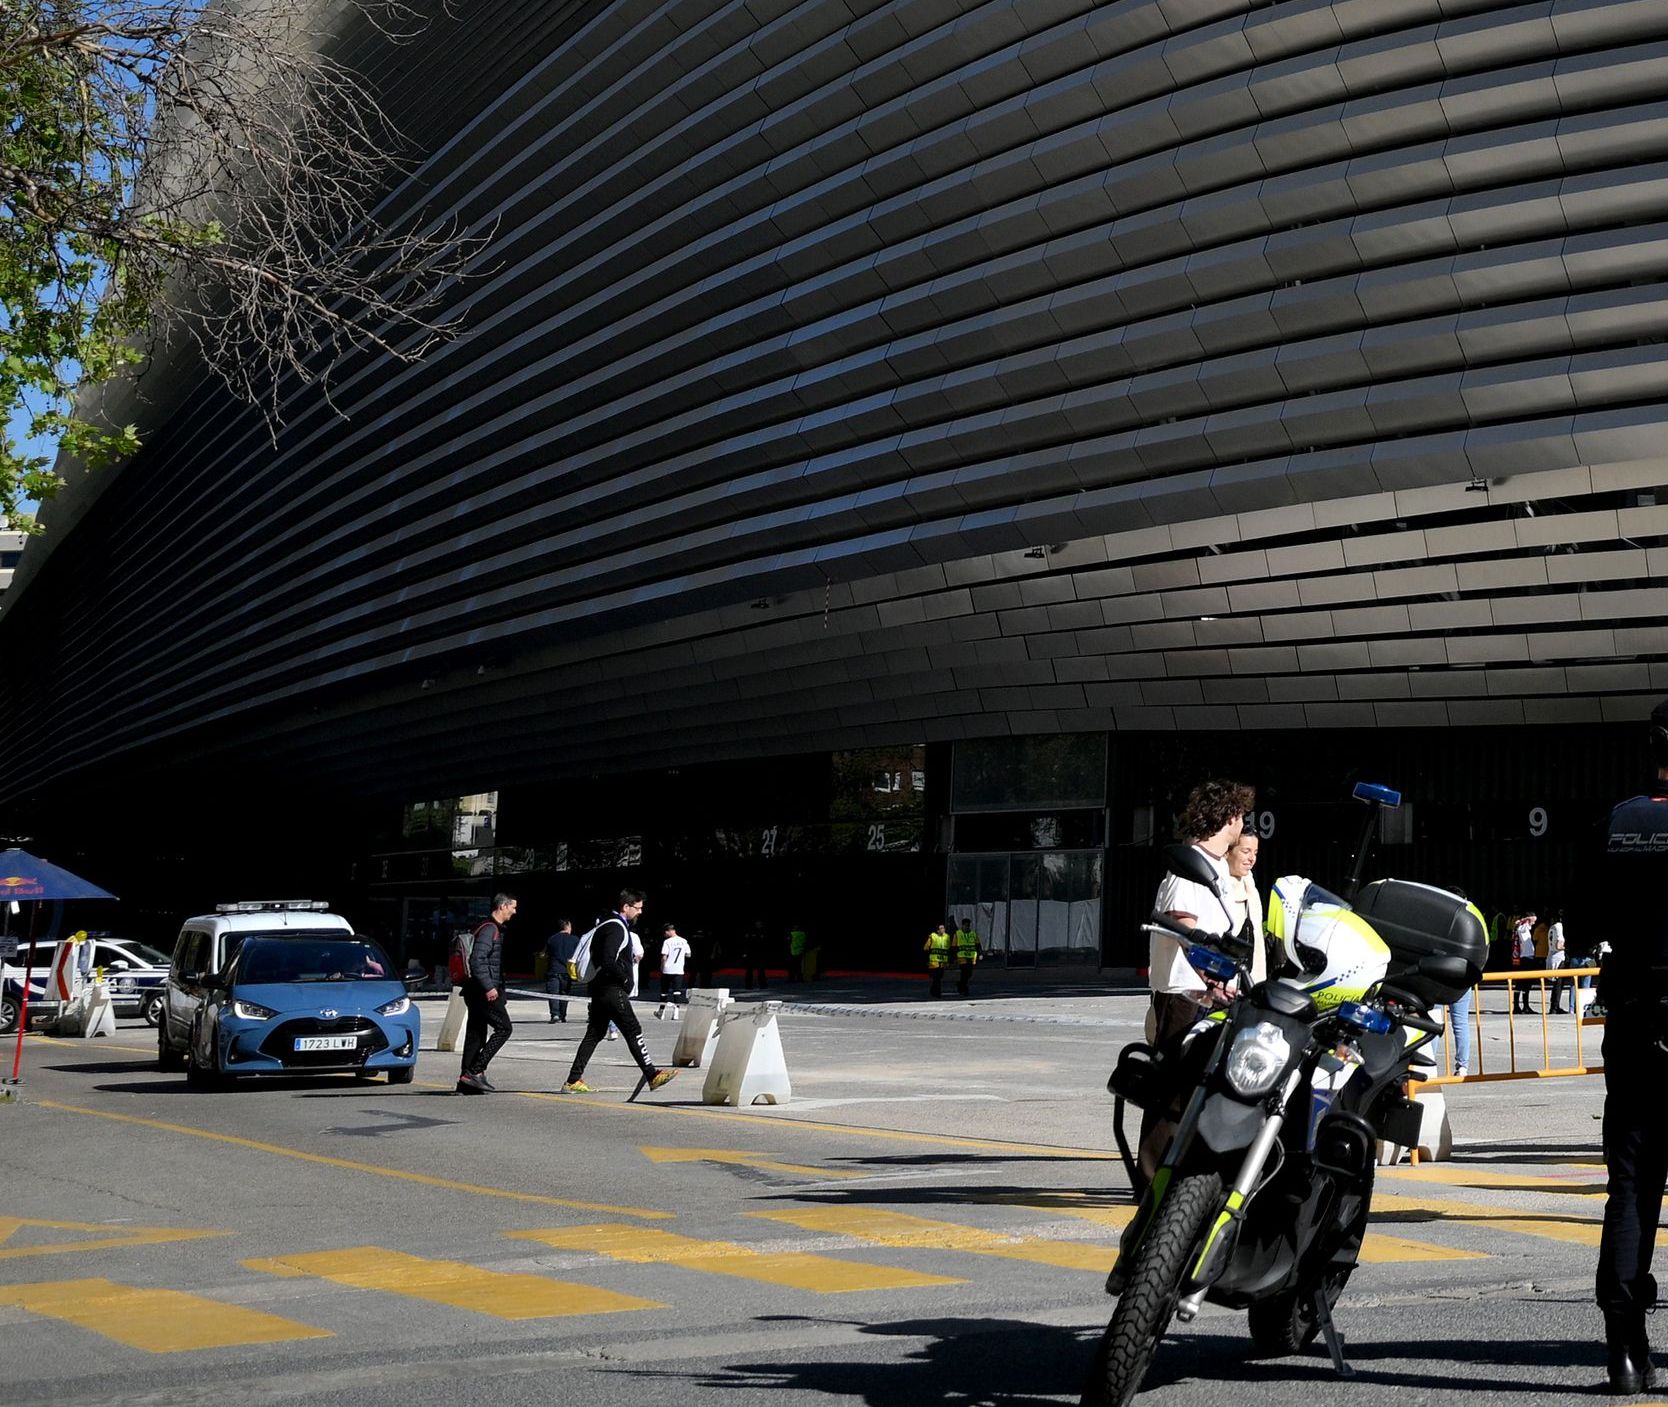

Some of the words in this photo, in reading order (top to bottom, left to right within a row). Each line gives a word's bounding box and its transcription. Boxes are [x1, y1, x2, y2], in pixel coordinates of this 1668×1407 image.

[1528, 807, 1548, 837] 9
[867, 824, 885, 851] 25
[673, 947, 682, 964] 7
[303, 1038, 330, 1050] 1723
